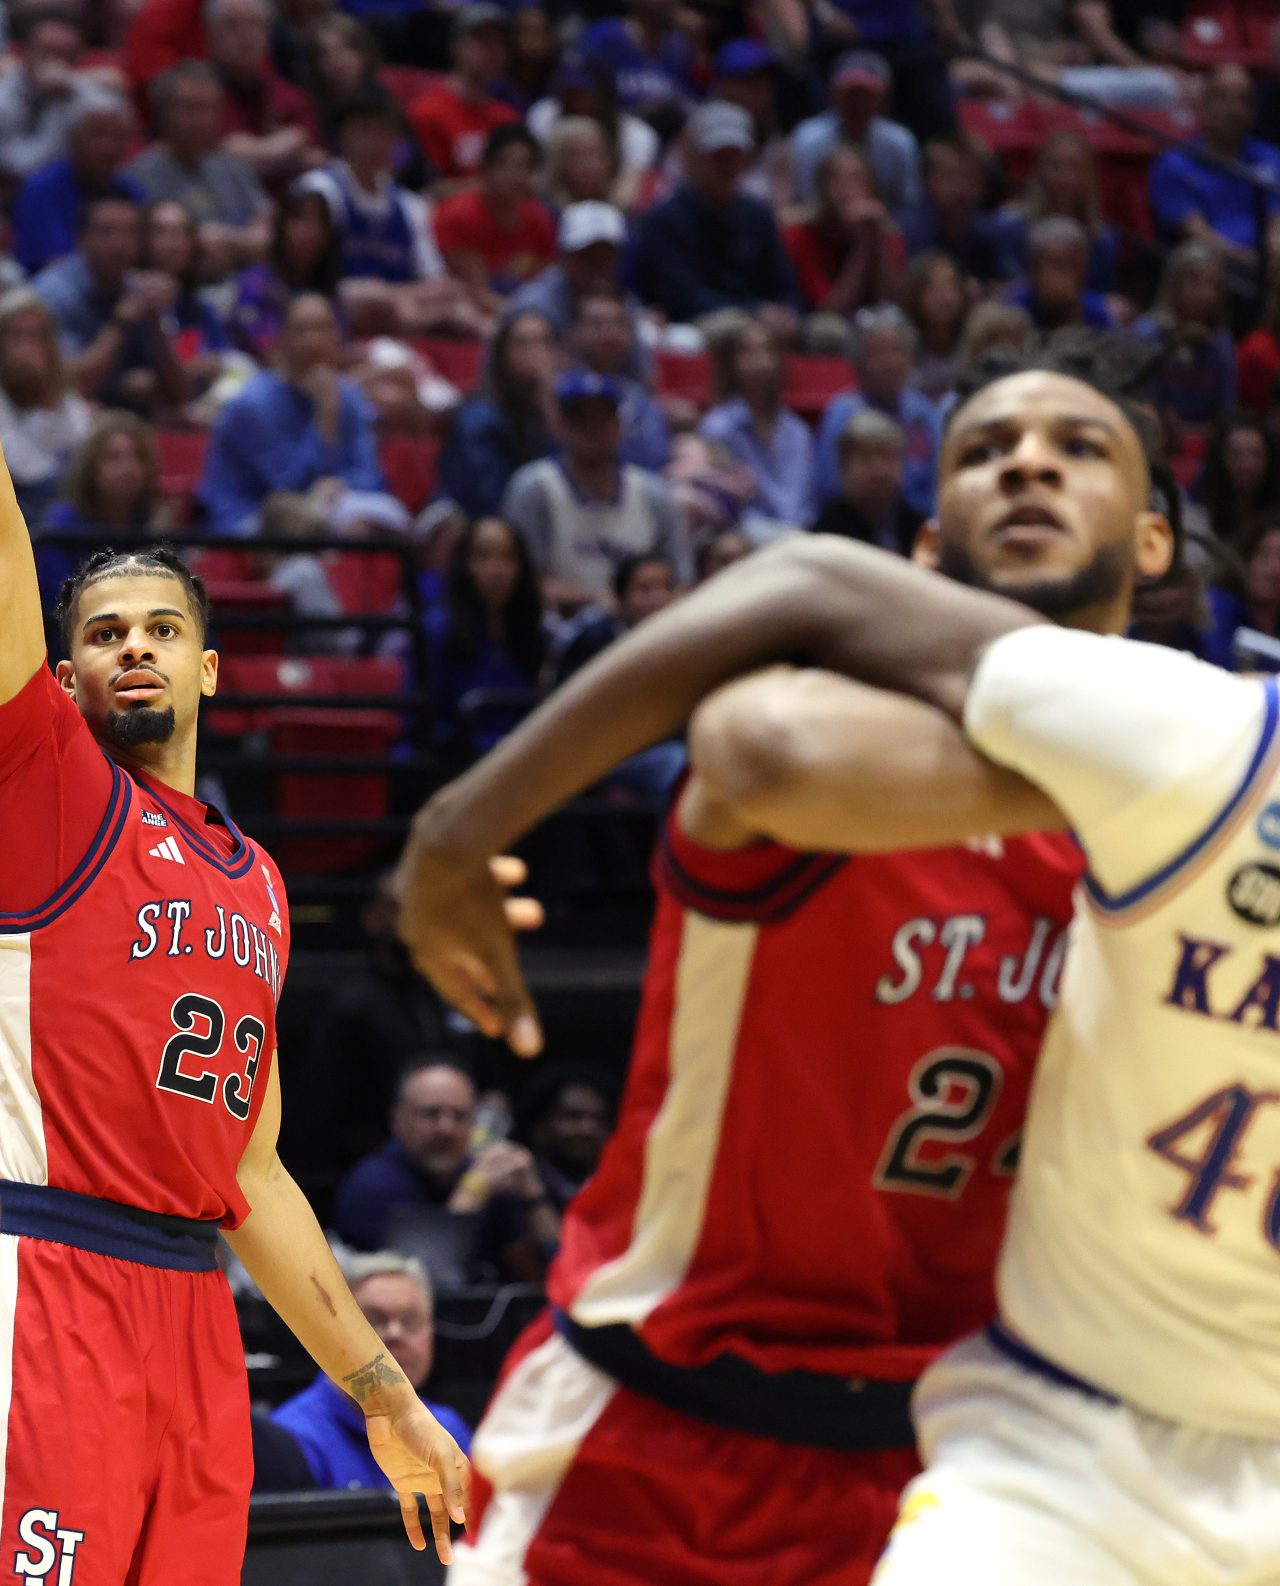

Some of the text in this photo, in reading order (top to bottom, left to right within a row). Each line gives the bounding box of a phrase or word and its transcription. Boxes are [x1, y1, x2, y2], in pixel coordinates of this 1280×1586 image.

[145, 811, 163, 820] THE
[128, 900, 194, 963] ST.
[875, 914, 986, 1004] ST.
[156, 992, 266, 1121] 23
[872, 1045, 1024, 1200] 2
